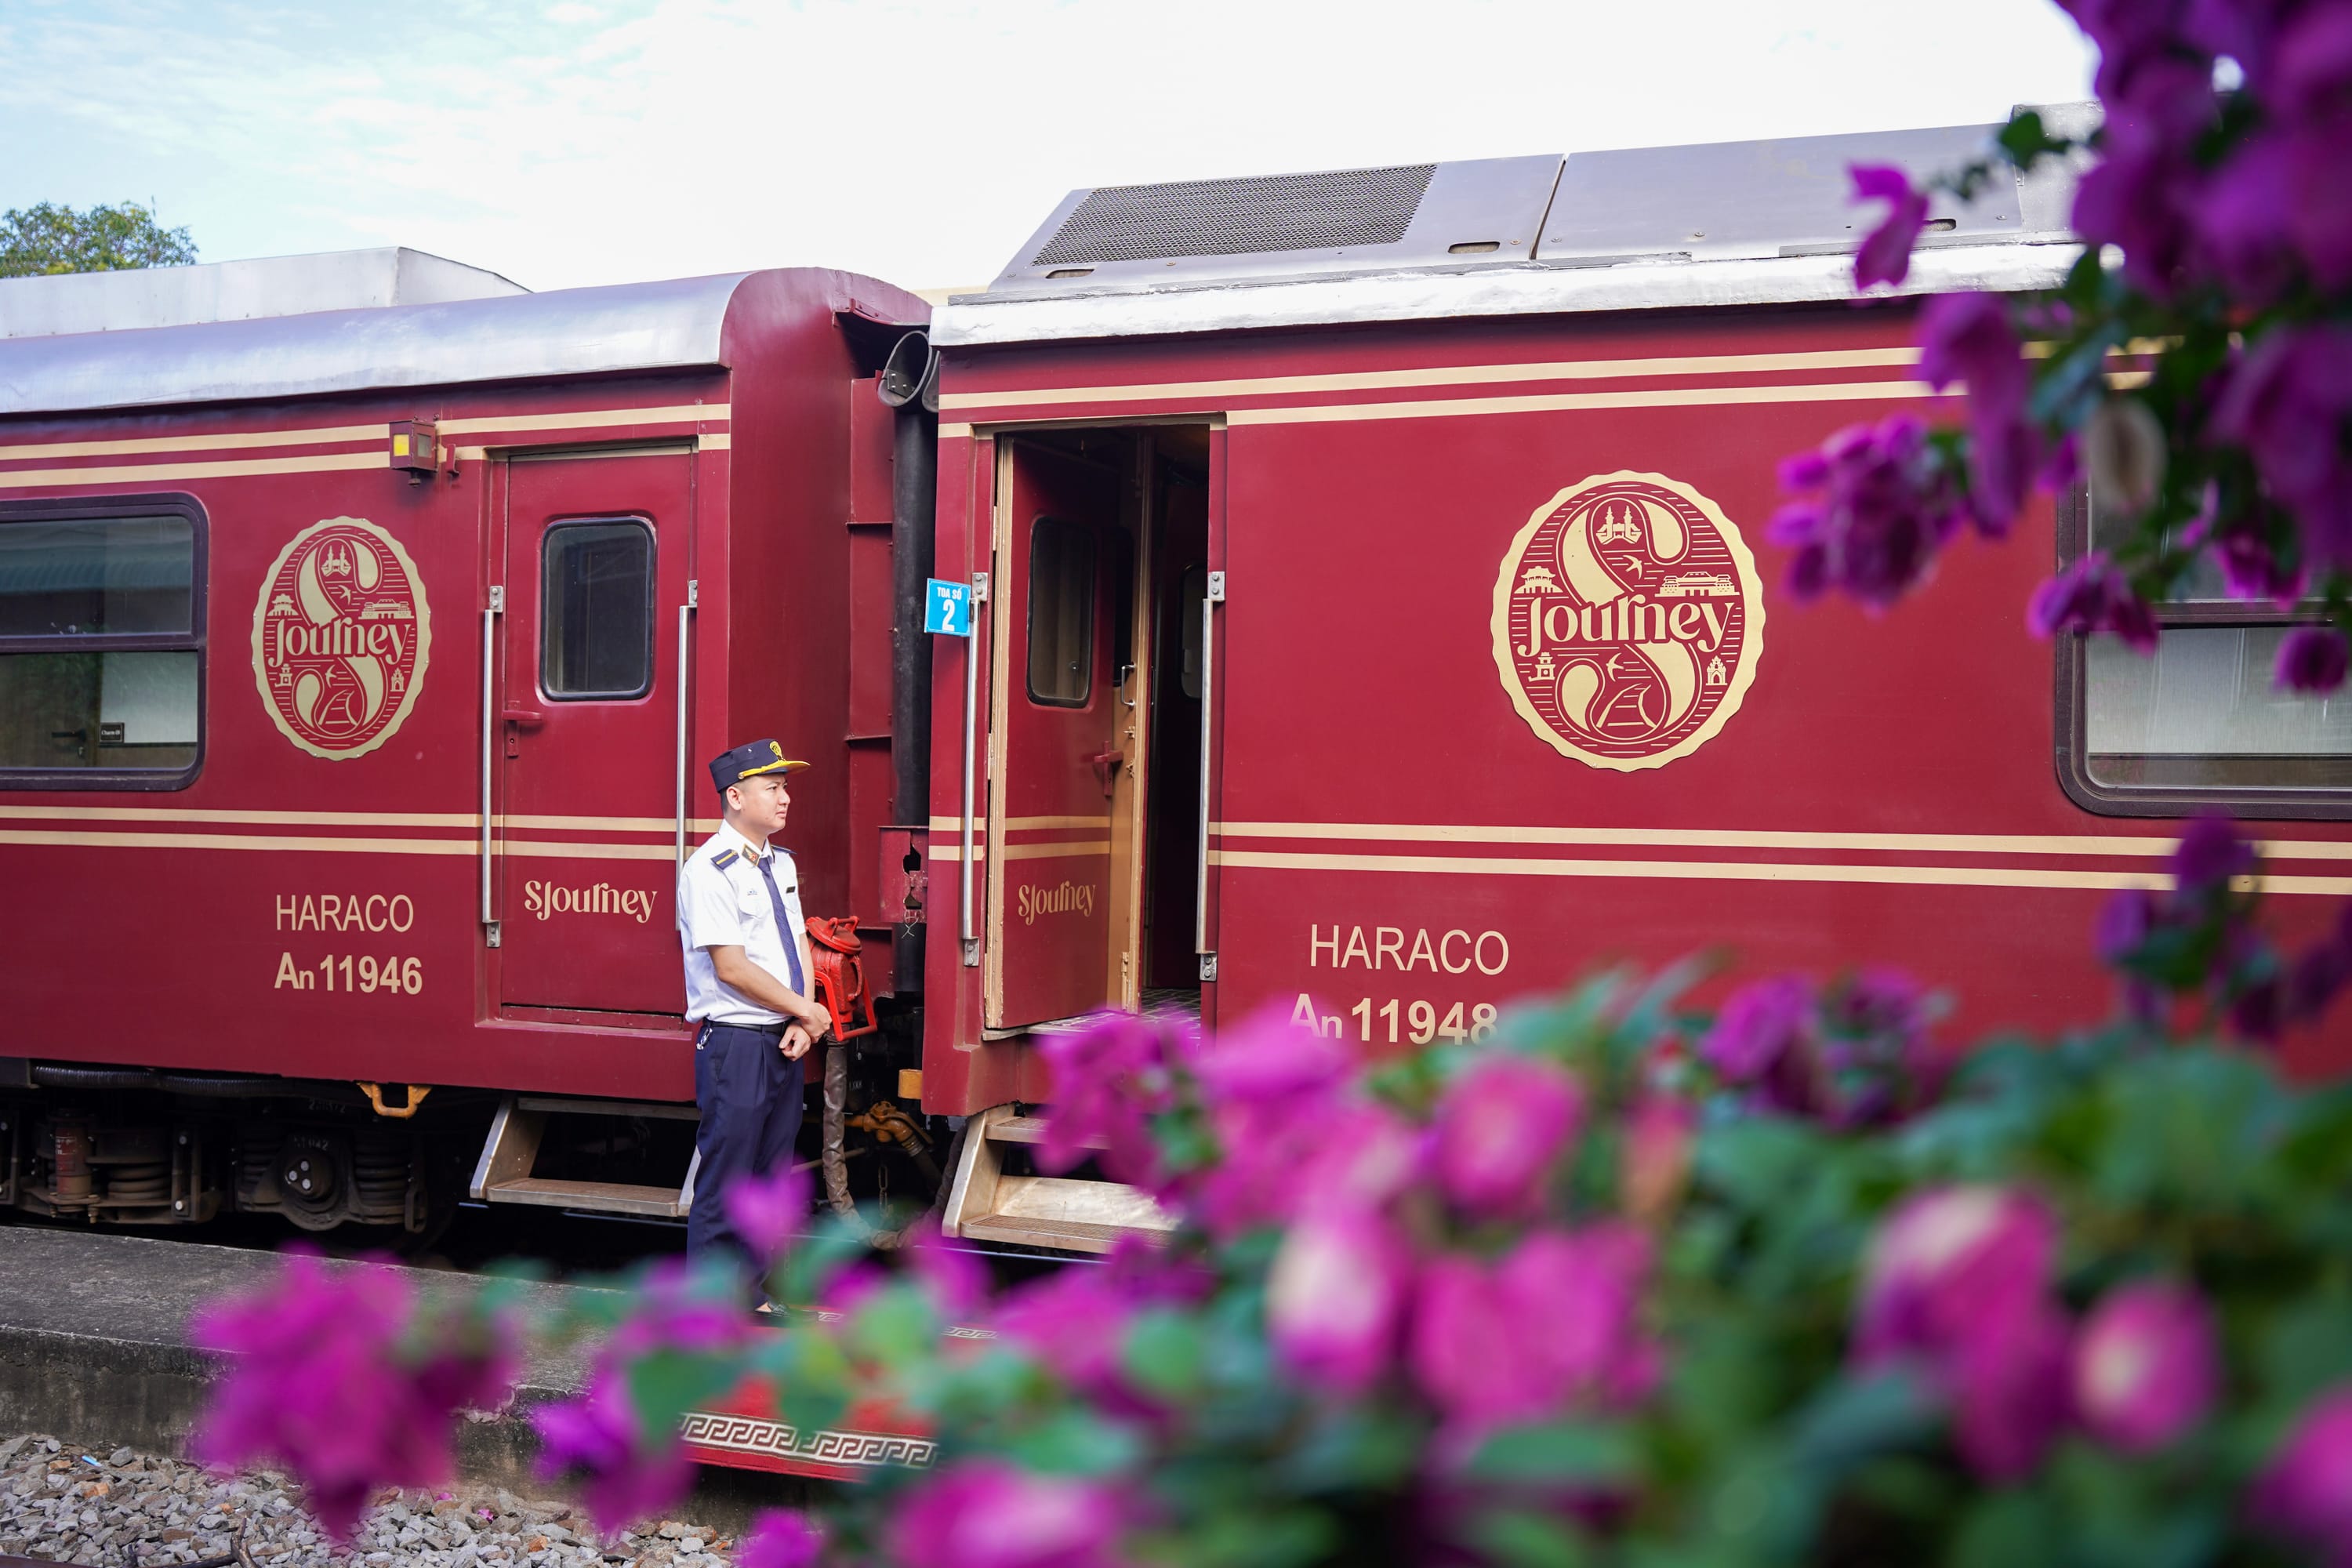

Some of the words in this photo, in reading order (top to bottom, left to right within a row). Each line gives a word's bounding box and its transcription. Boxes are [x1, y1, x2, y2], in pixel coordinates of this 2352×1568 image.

[937, 586, 951, 599] TOA
[942, 598, 956, 632] 2
[276, 894, 415, 933] HARACO
[1310, 924, 1510, 976] HARACO
[274, 951, 314, 990] An
[319, 953, 423, 996] 11946
[1289, 993, 1343, 1040] An
[1351, 996, 1499, 1047] 11948
